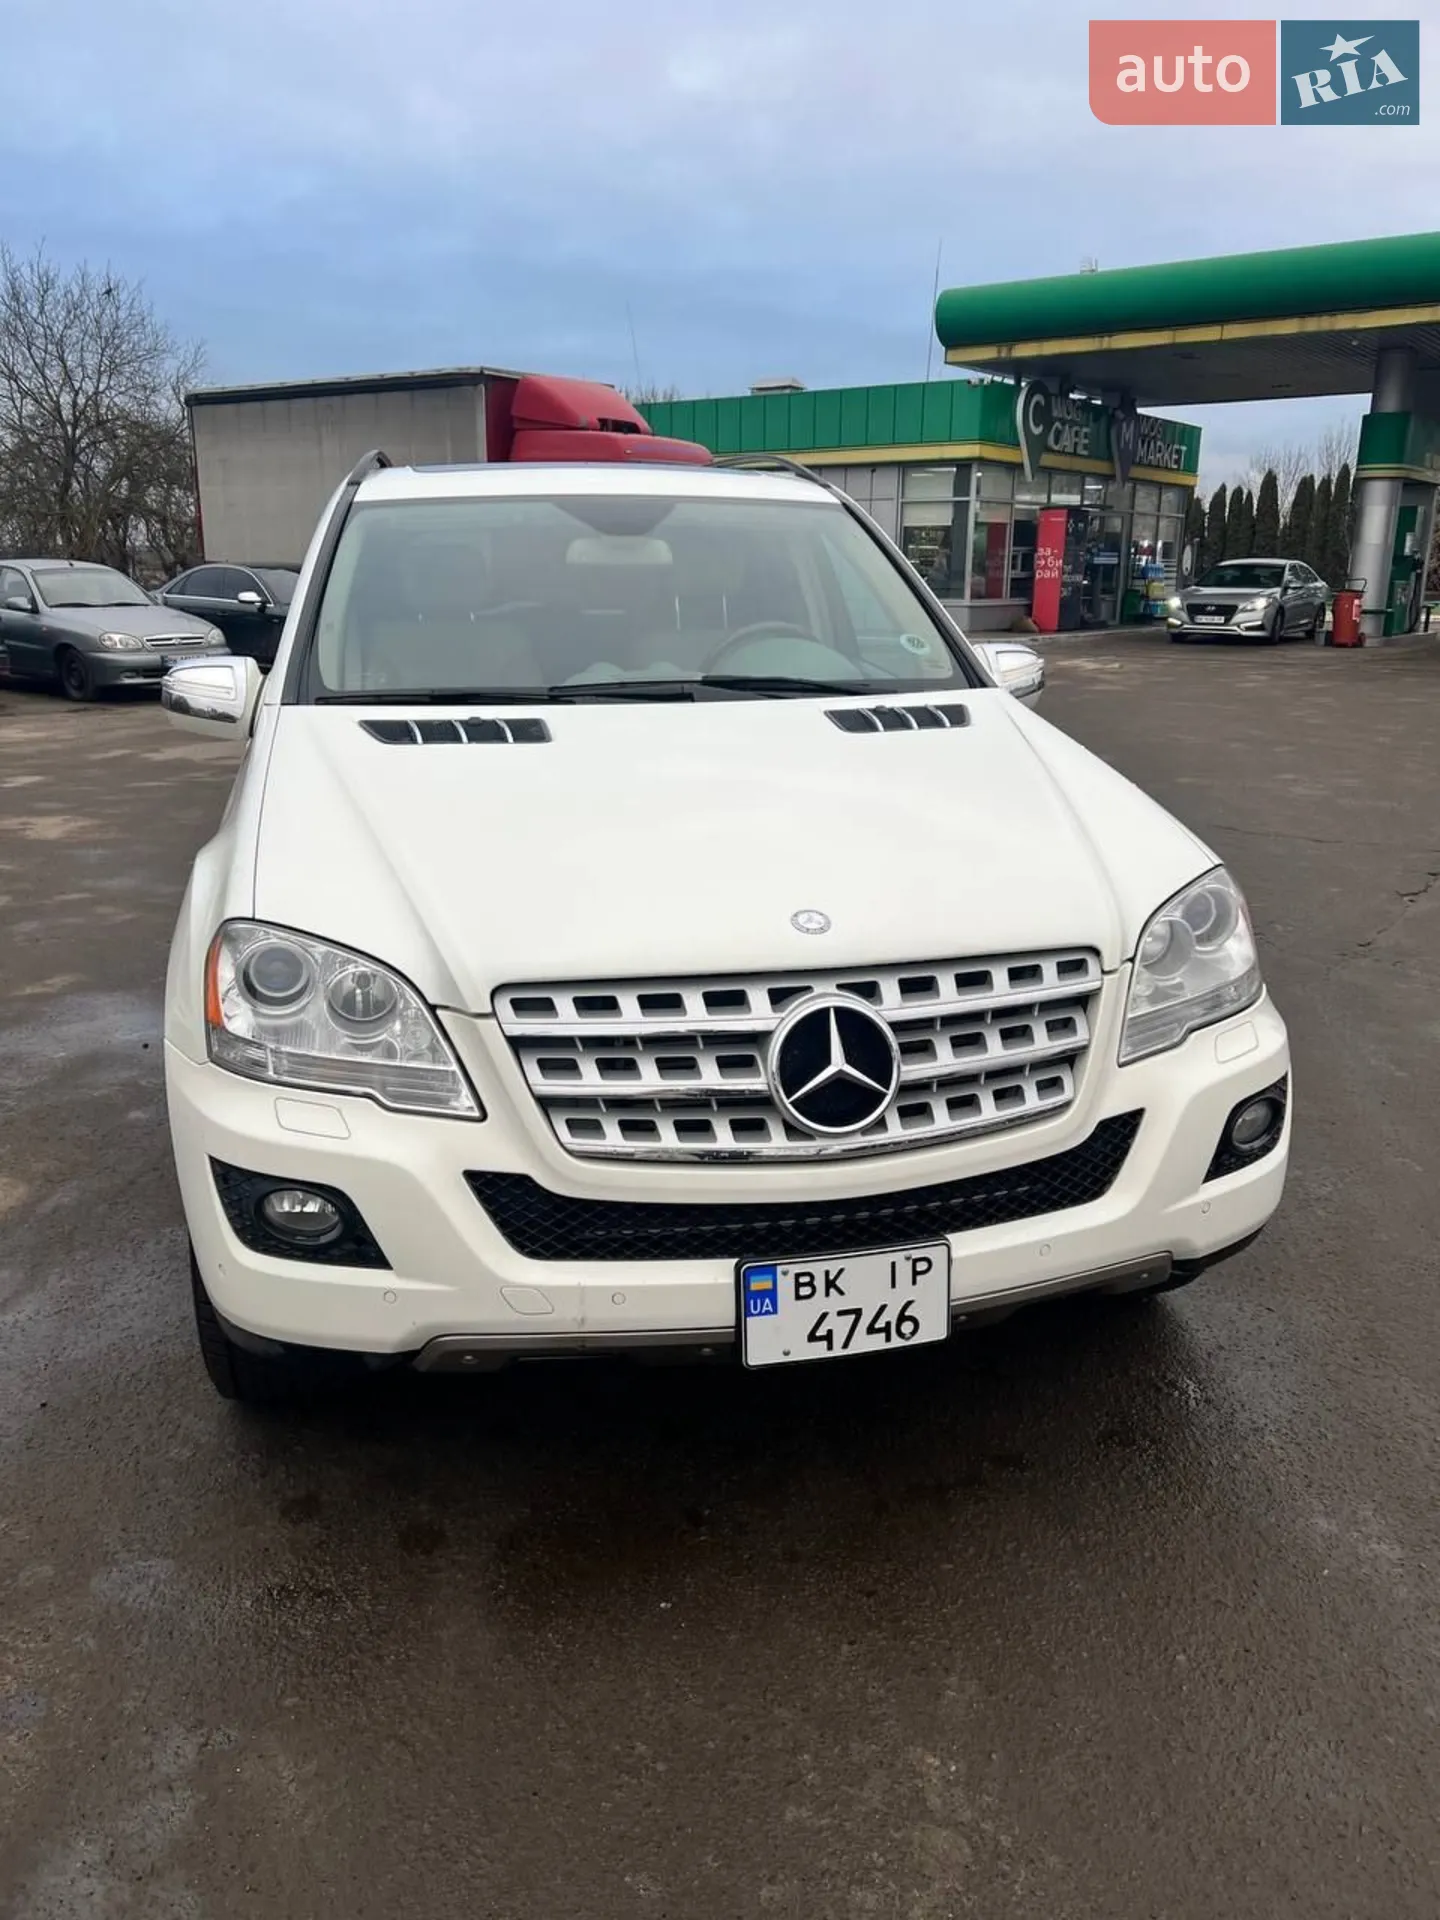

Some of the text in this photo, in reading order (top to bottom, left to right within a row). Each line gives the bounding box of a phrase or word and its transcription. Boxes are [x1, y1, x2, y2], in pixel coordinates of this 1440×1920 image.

[1047, 421, 1091, 455] CAFE
[1136, 437, 1188, 470] MARKET
[750, 1298, 774, 1315] UA
[807, 1300, 920, 1351] 4746
